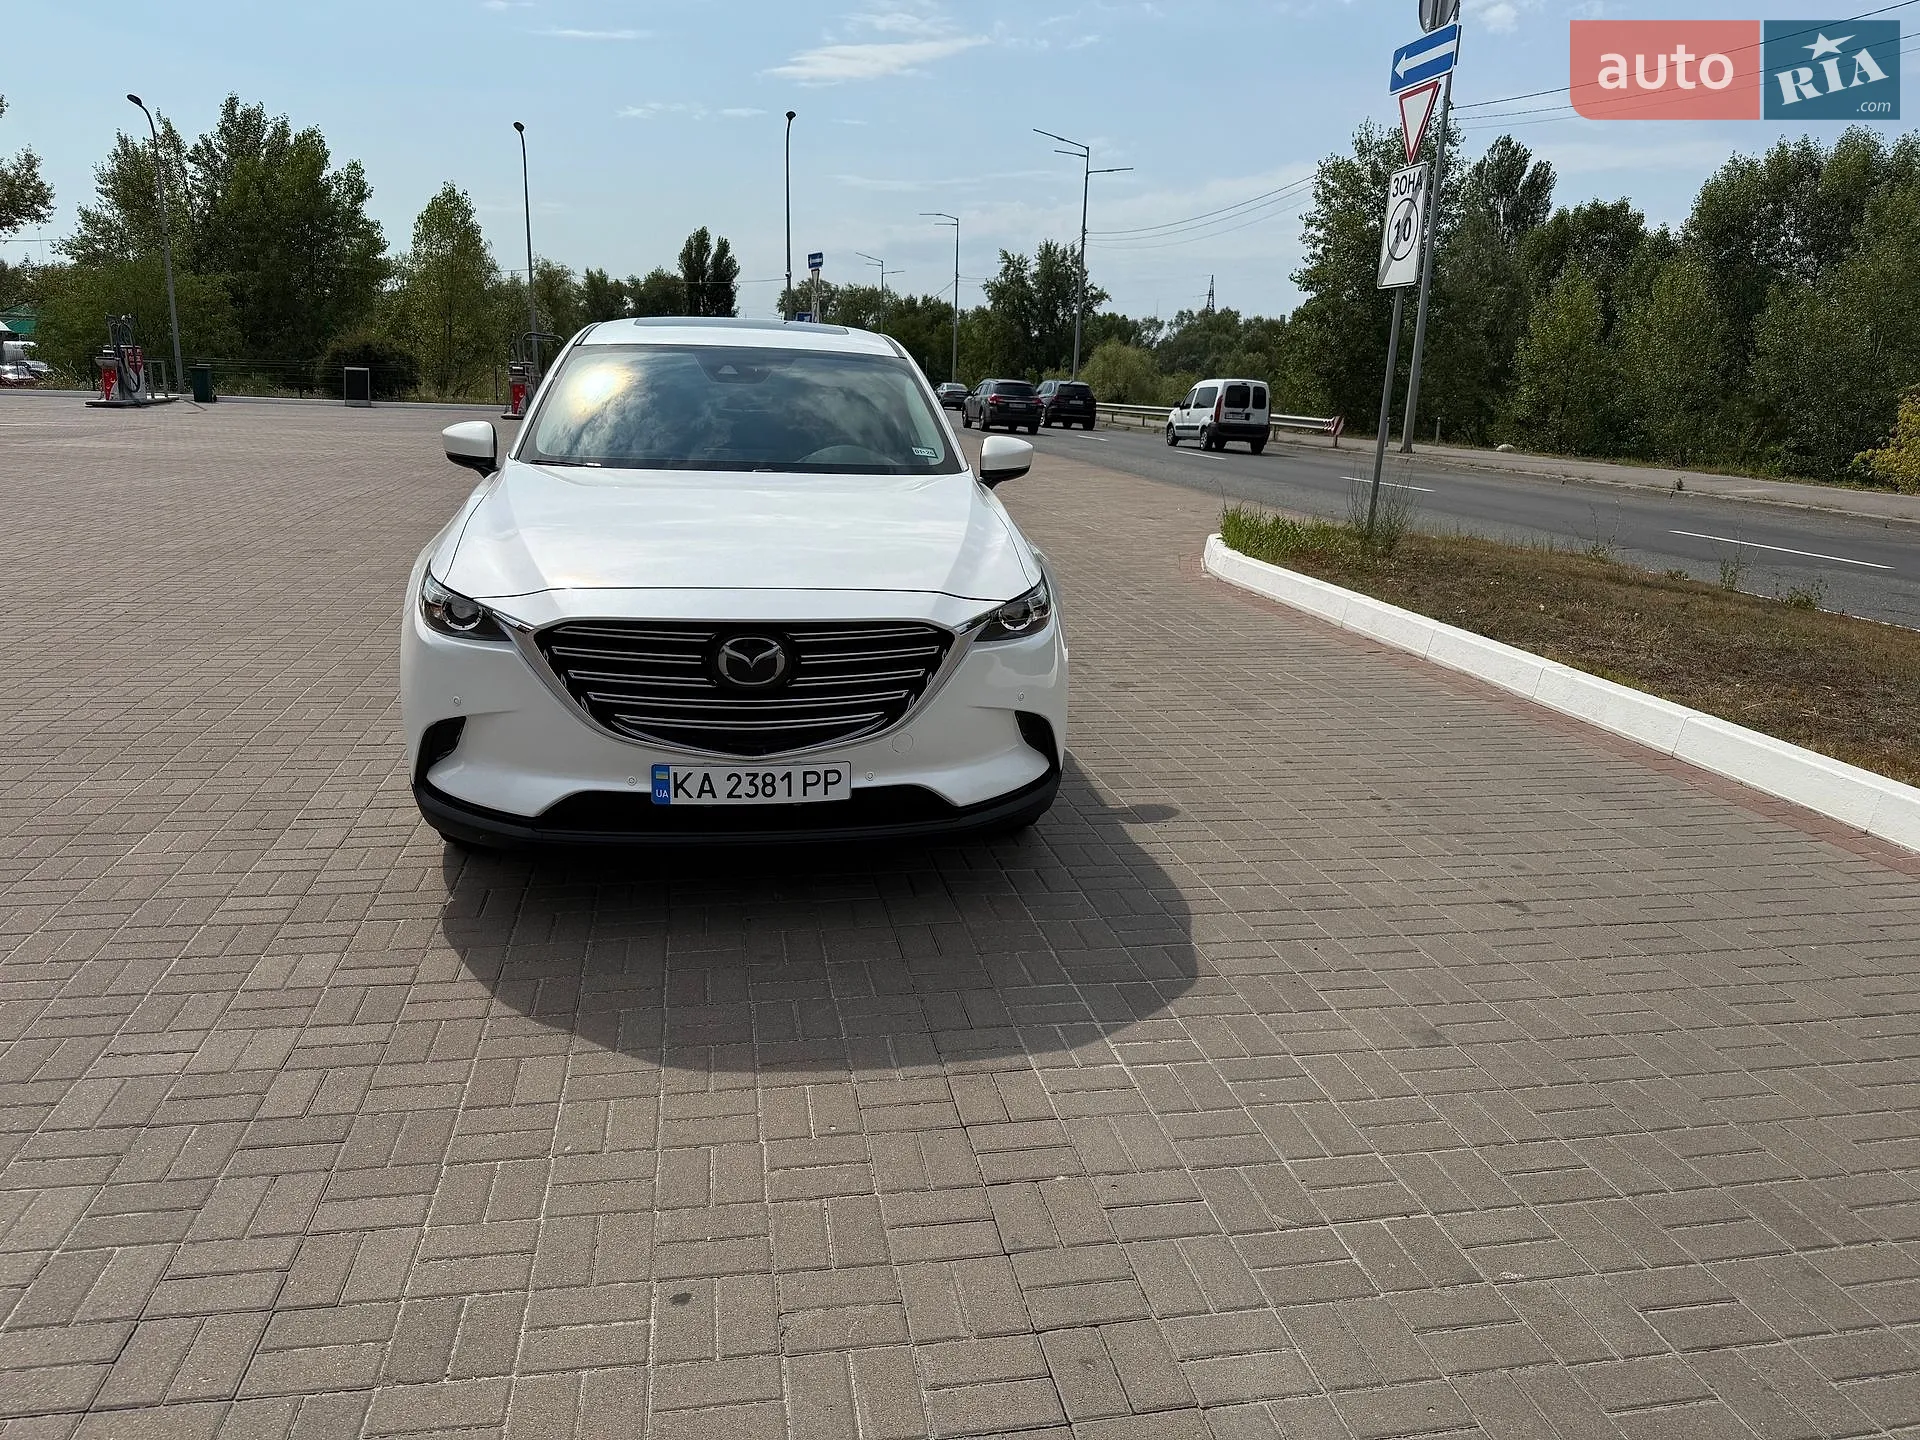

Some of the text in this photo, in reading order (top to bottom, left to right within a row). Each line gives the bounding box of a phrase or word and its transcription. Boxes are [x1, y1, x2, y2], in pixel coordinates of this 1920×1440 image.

[1392, 171, 1423, 198] ЗОНА
[1394, 217, 1412, 243] 10
[655, 789, 669, 798] UA
[673, 769, 842, 799] KA 2381 PP
